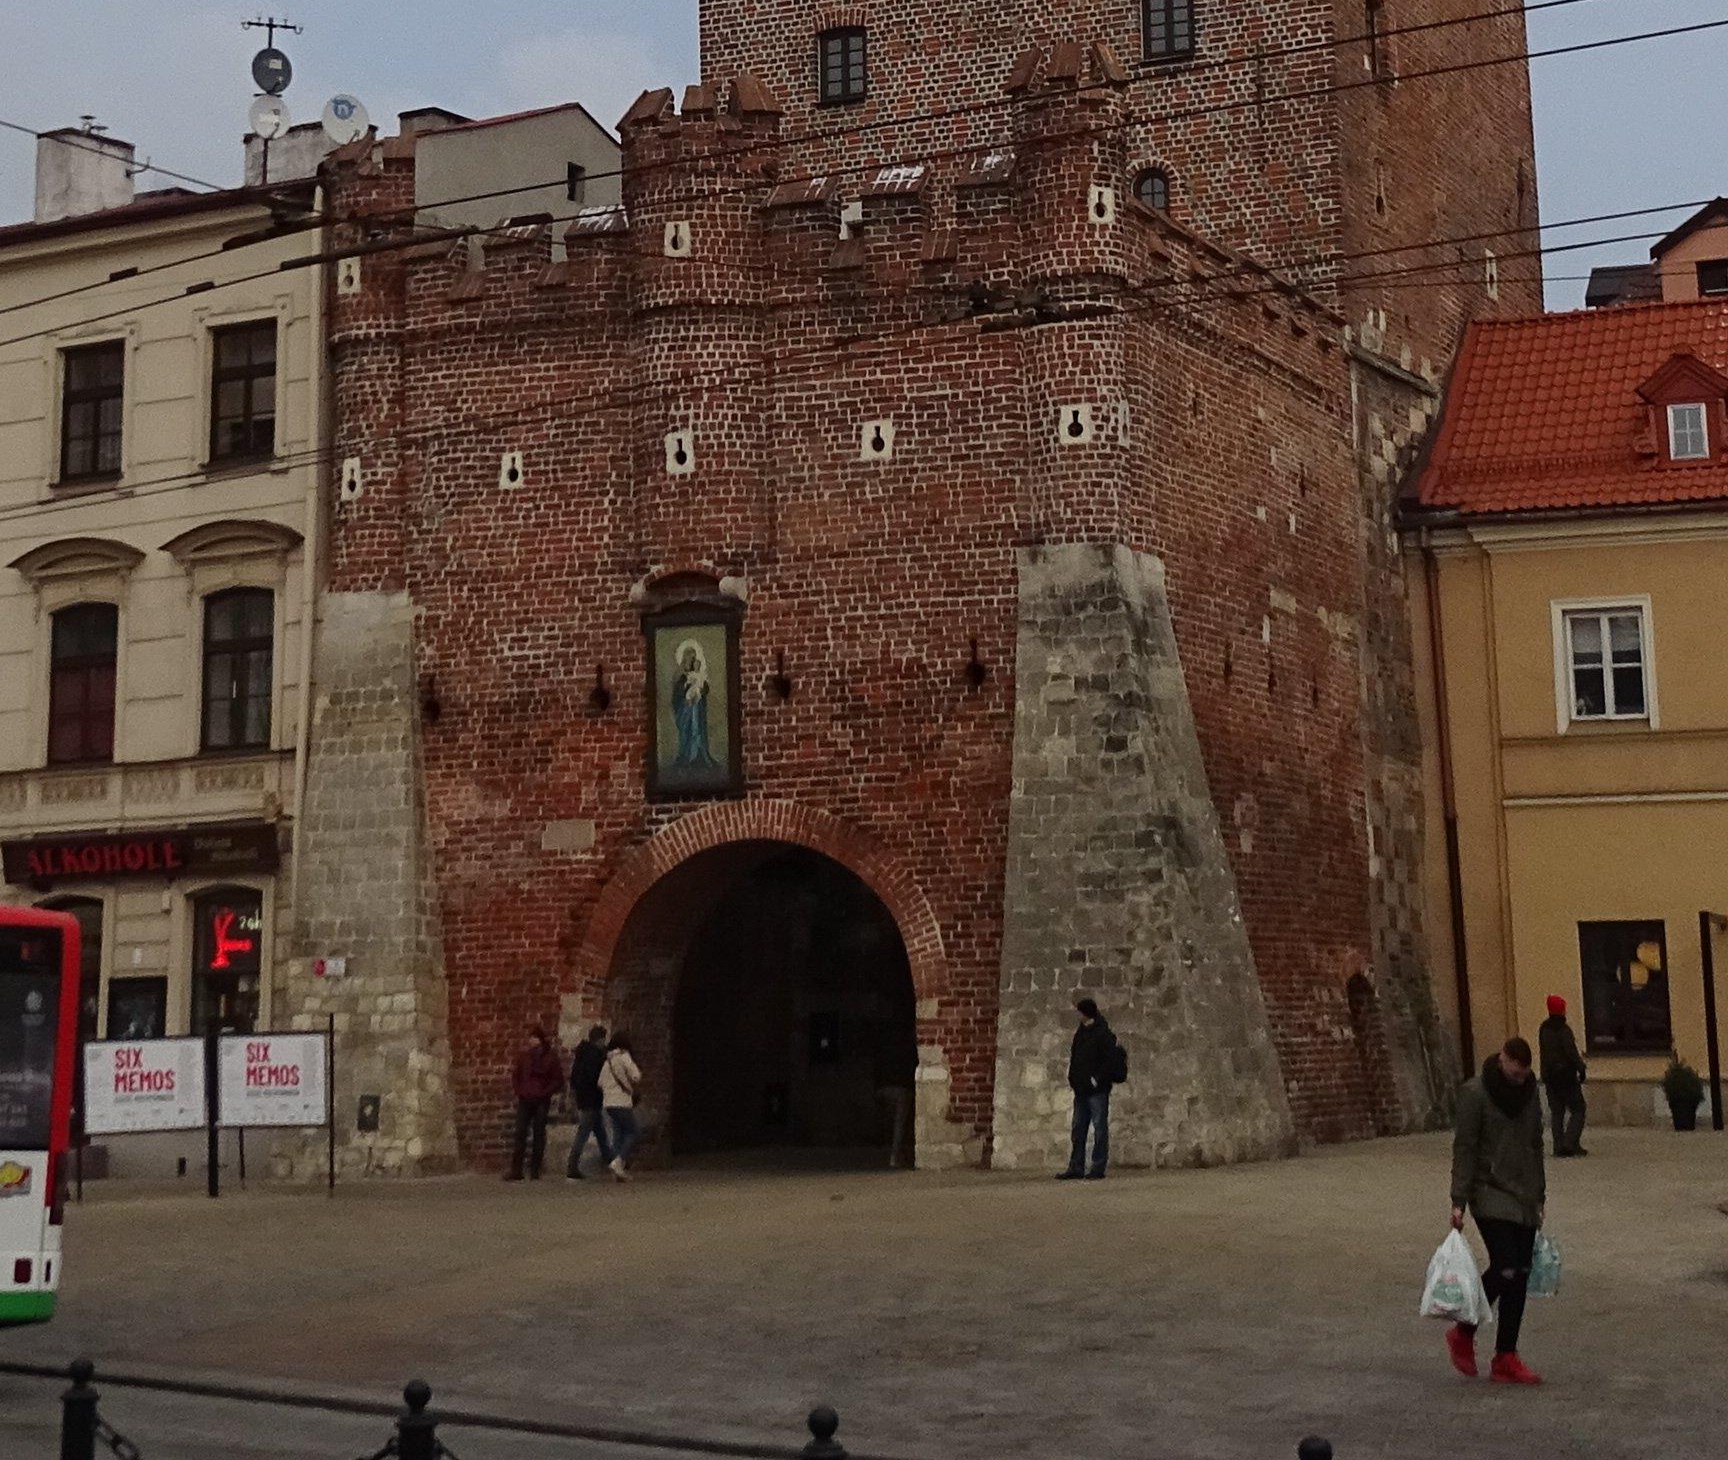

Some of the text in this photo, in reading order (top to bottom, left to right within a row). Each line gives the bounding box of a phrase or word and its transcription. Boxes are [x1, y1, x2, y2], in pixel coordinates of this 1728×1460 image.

[114, 1047, 143, 1070] SIX
[245, 1042, 271, 1063] SIX
[114, 1068, 176, 1093] MEMOS
[246, 1065, 300, 1087] MEMOS
